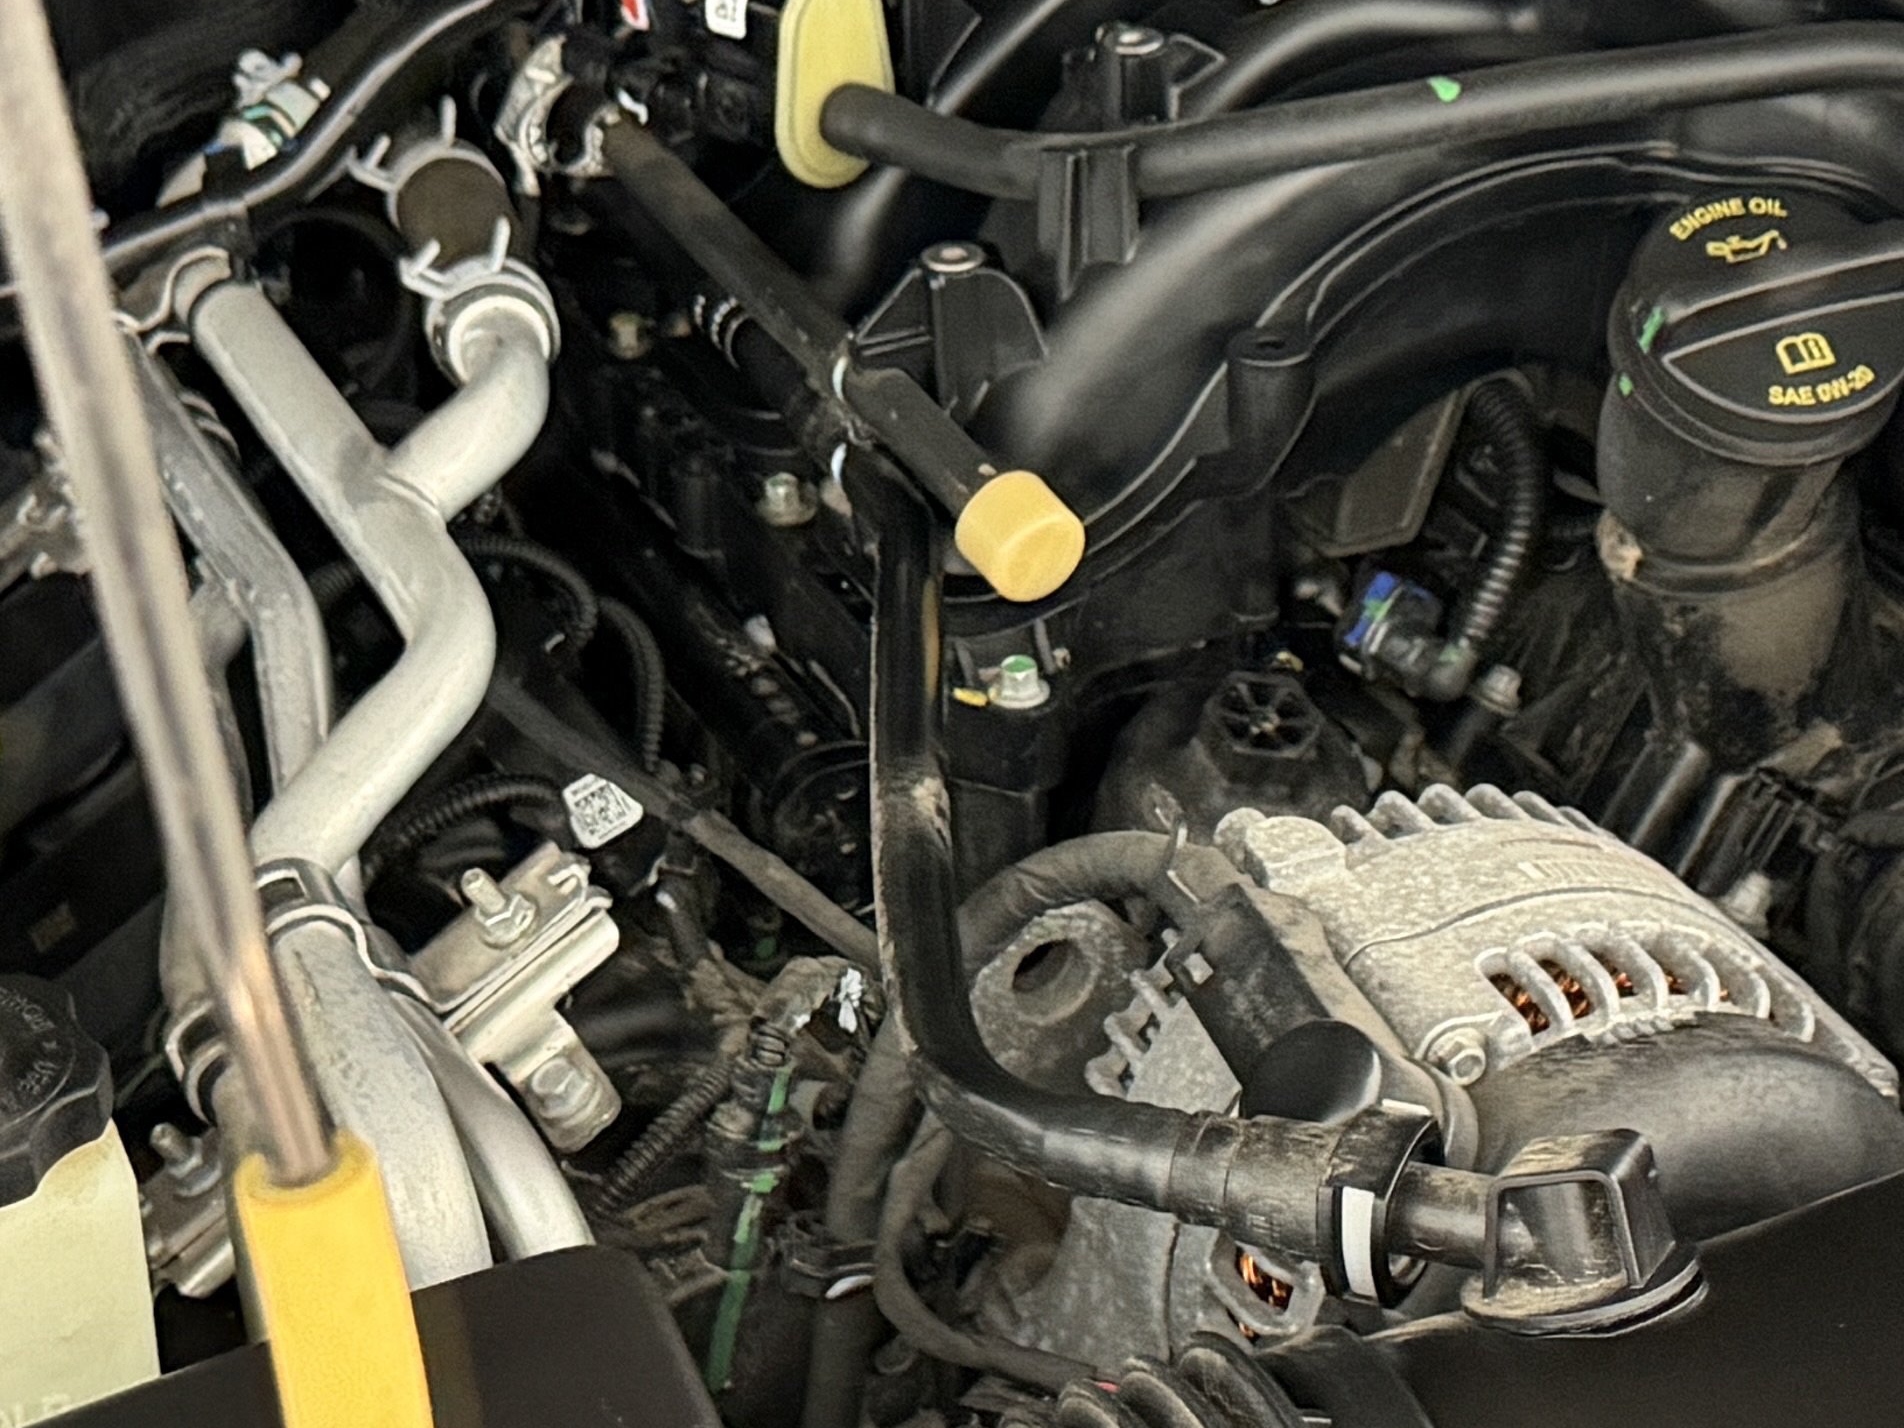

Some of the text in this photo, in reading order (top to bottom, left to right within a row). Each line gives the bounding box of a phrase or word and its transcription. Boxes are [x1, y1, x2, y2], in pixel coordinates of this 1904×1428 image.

[1669, 196, 1788, 241] ENGINE OIL
[1768, 364, 1876, 406] SAE 0W-20
